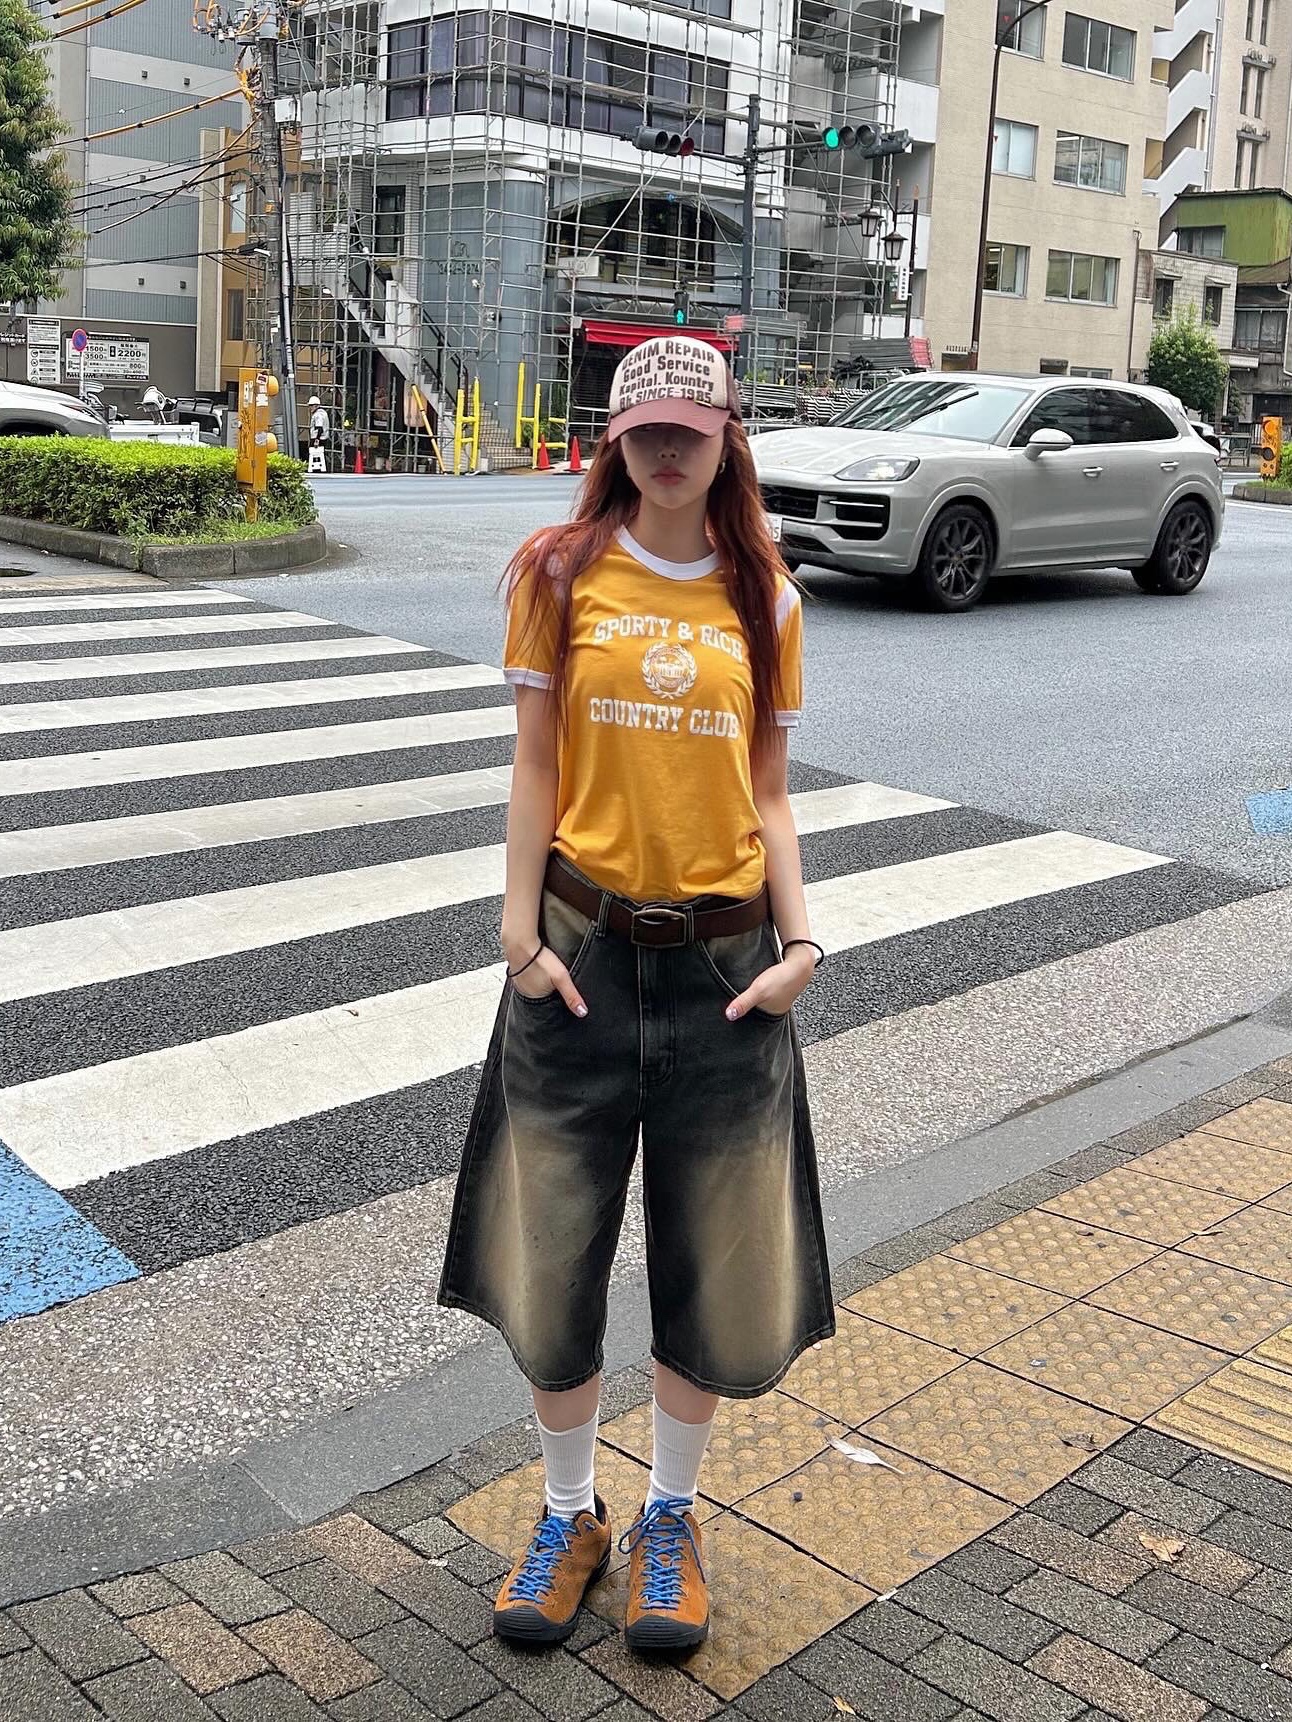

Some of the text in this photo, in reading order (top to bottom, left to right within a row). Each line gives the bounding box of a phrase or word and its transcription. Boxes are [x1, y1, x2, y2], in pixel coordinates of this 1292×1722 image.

[622, 340, 715, 370] DENIM REPAIR
[623, 355, 710, 383] Good Service
[665, 371, 714, 392] Kountry
[594, 614, 743, 663] SPORTY & RICH
[590, 697, 740, 740] COUNTRY CLUB
